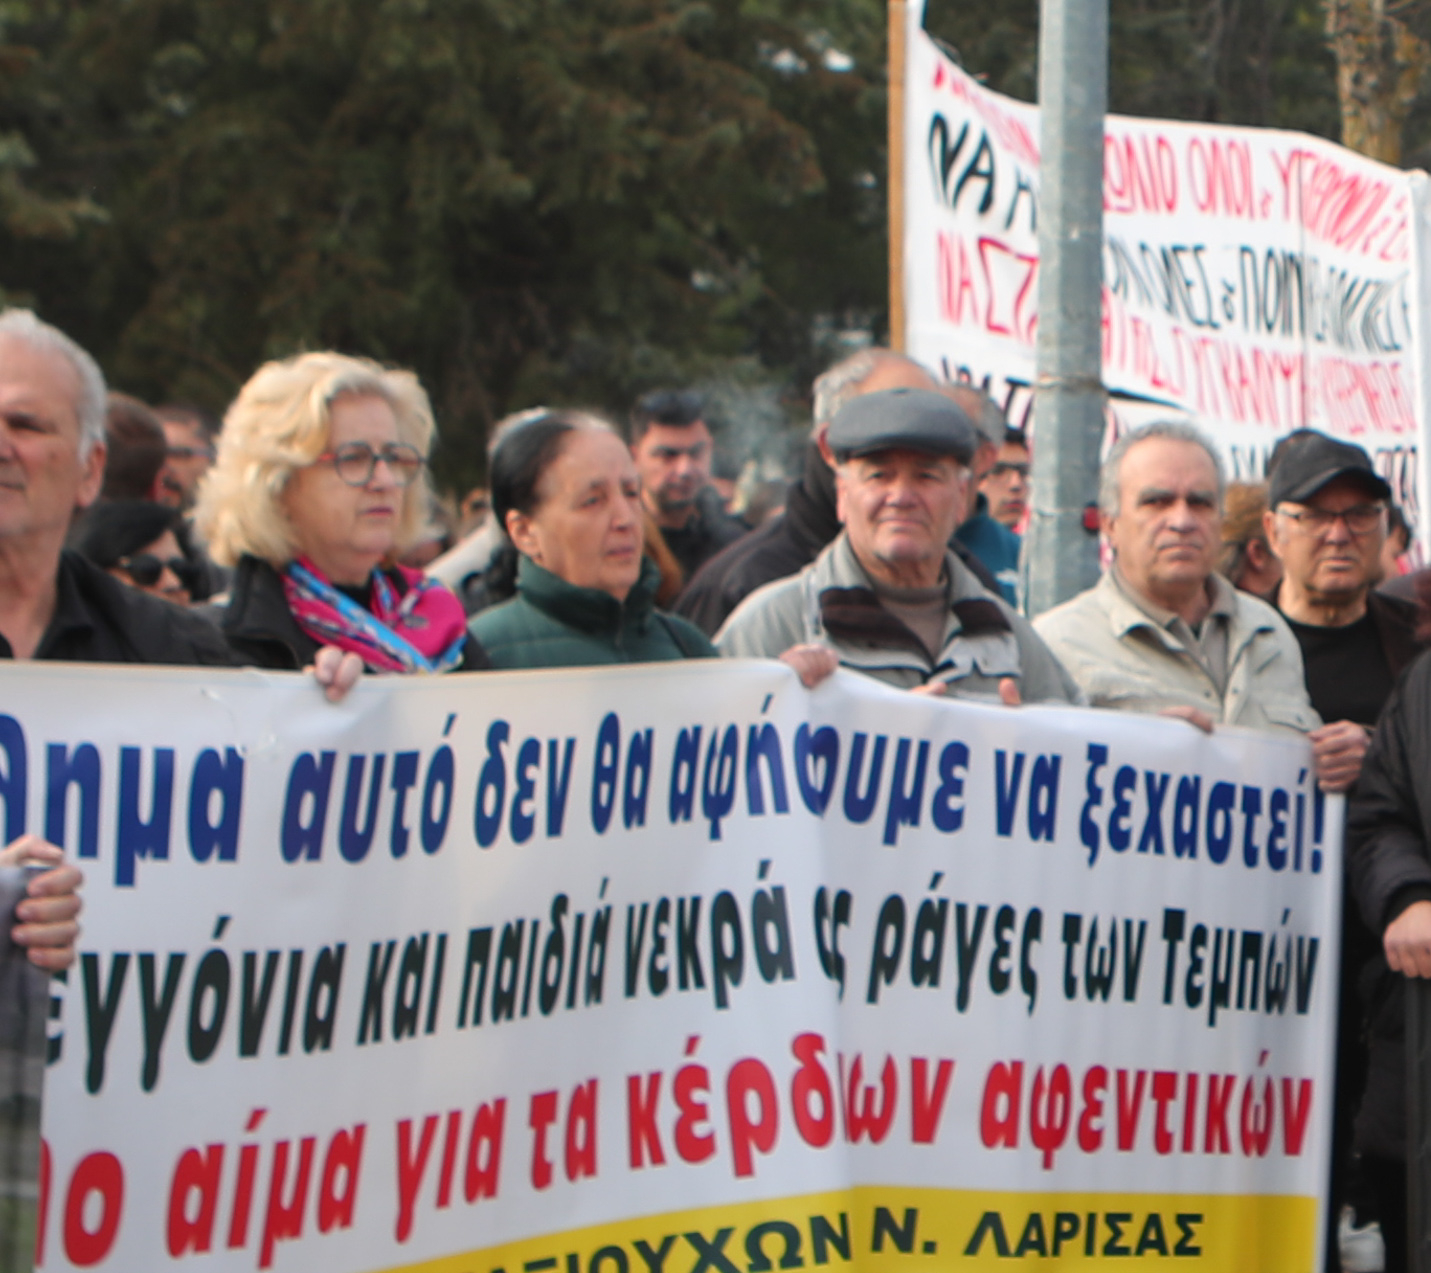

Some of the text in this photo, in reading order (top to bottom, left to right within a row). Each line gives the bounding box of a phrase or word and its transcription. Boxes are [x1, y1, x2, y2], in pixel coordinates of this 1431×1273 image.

[927, 110, 996, 214] ΝΑ
[280, 713, 457, 864] αυτό
[473, 719, 577, 849] δεν
[590, 712, 654, 836] θα
[994, 747, 1063, 844] να
[1078, 743, 1326, 875] ξεχαστεί!
[356, 932, 448, 1046] και
[457, 877, 612, 1029] παιδιά
[624, 859, 796, 1010] νεκρά
[866, 871, 1044, 1016] ράγες
[1062, 912, 1147, 1002] των
[1161, 909, 1320, 1027] Τεμπών
[165, 1107, 368, 1271] αίμα
[396, 1097, 507, 1244] για
[529, 1077, 599, 1191] τα
[979, 1050, 1315, 1170] αφεντικών
[871, 1207, 938, 1255] Ν.
[963, 1211, 1205, 1258] ΛΑΡΙΣΑΣ
